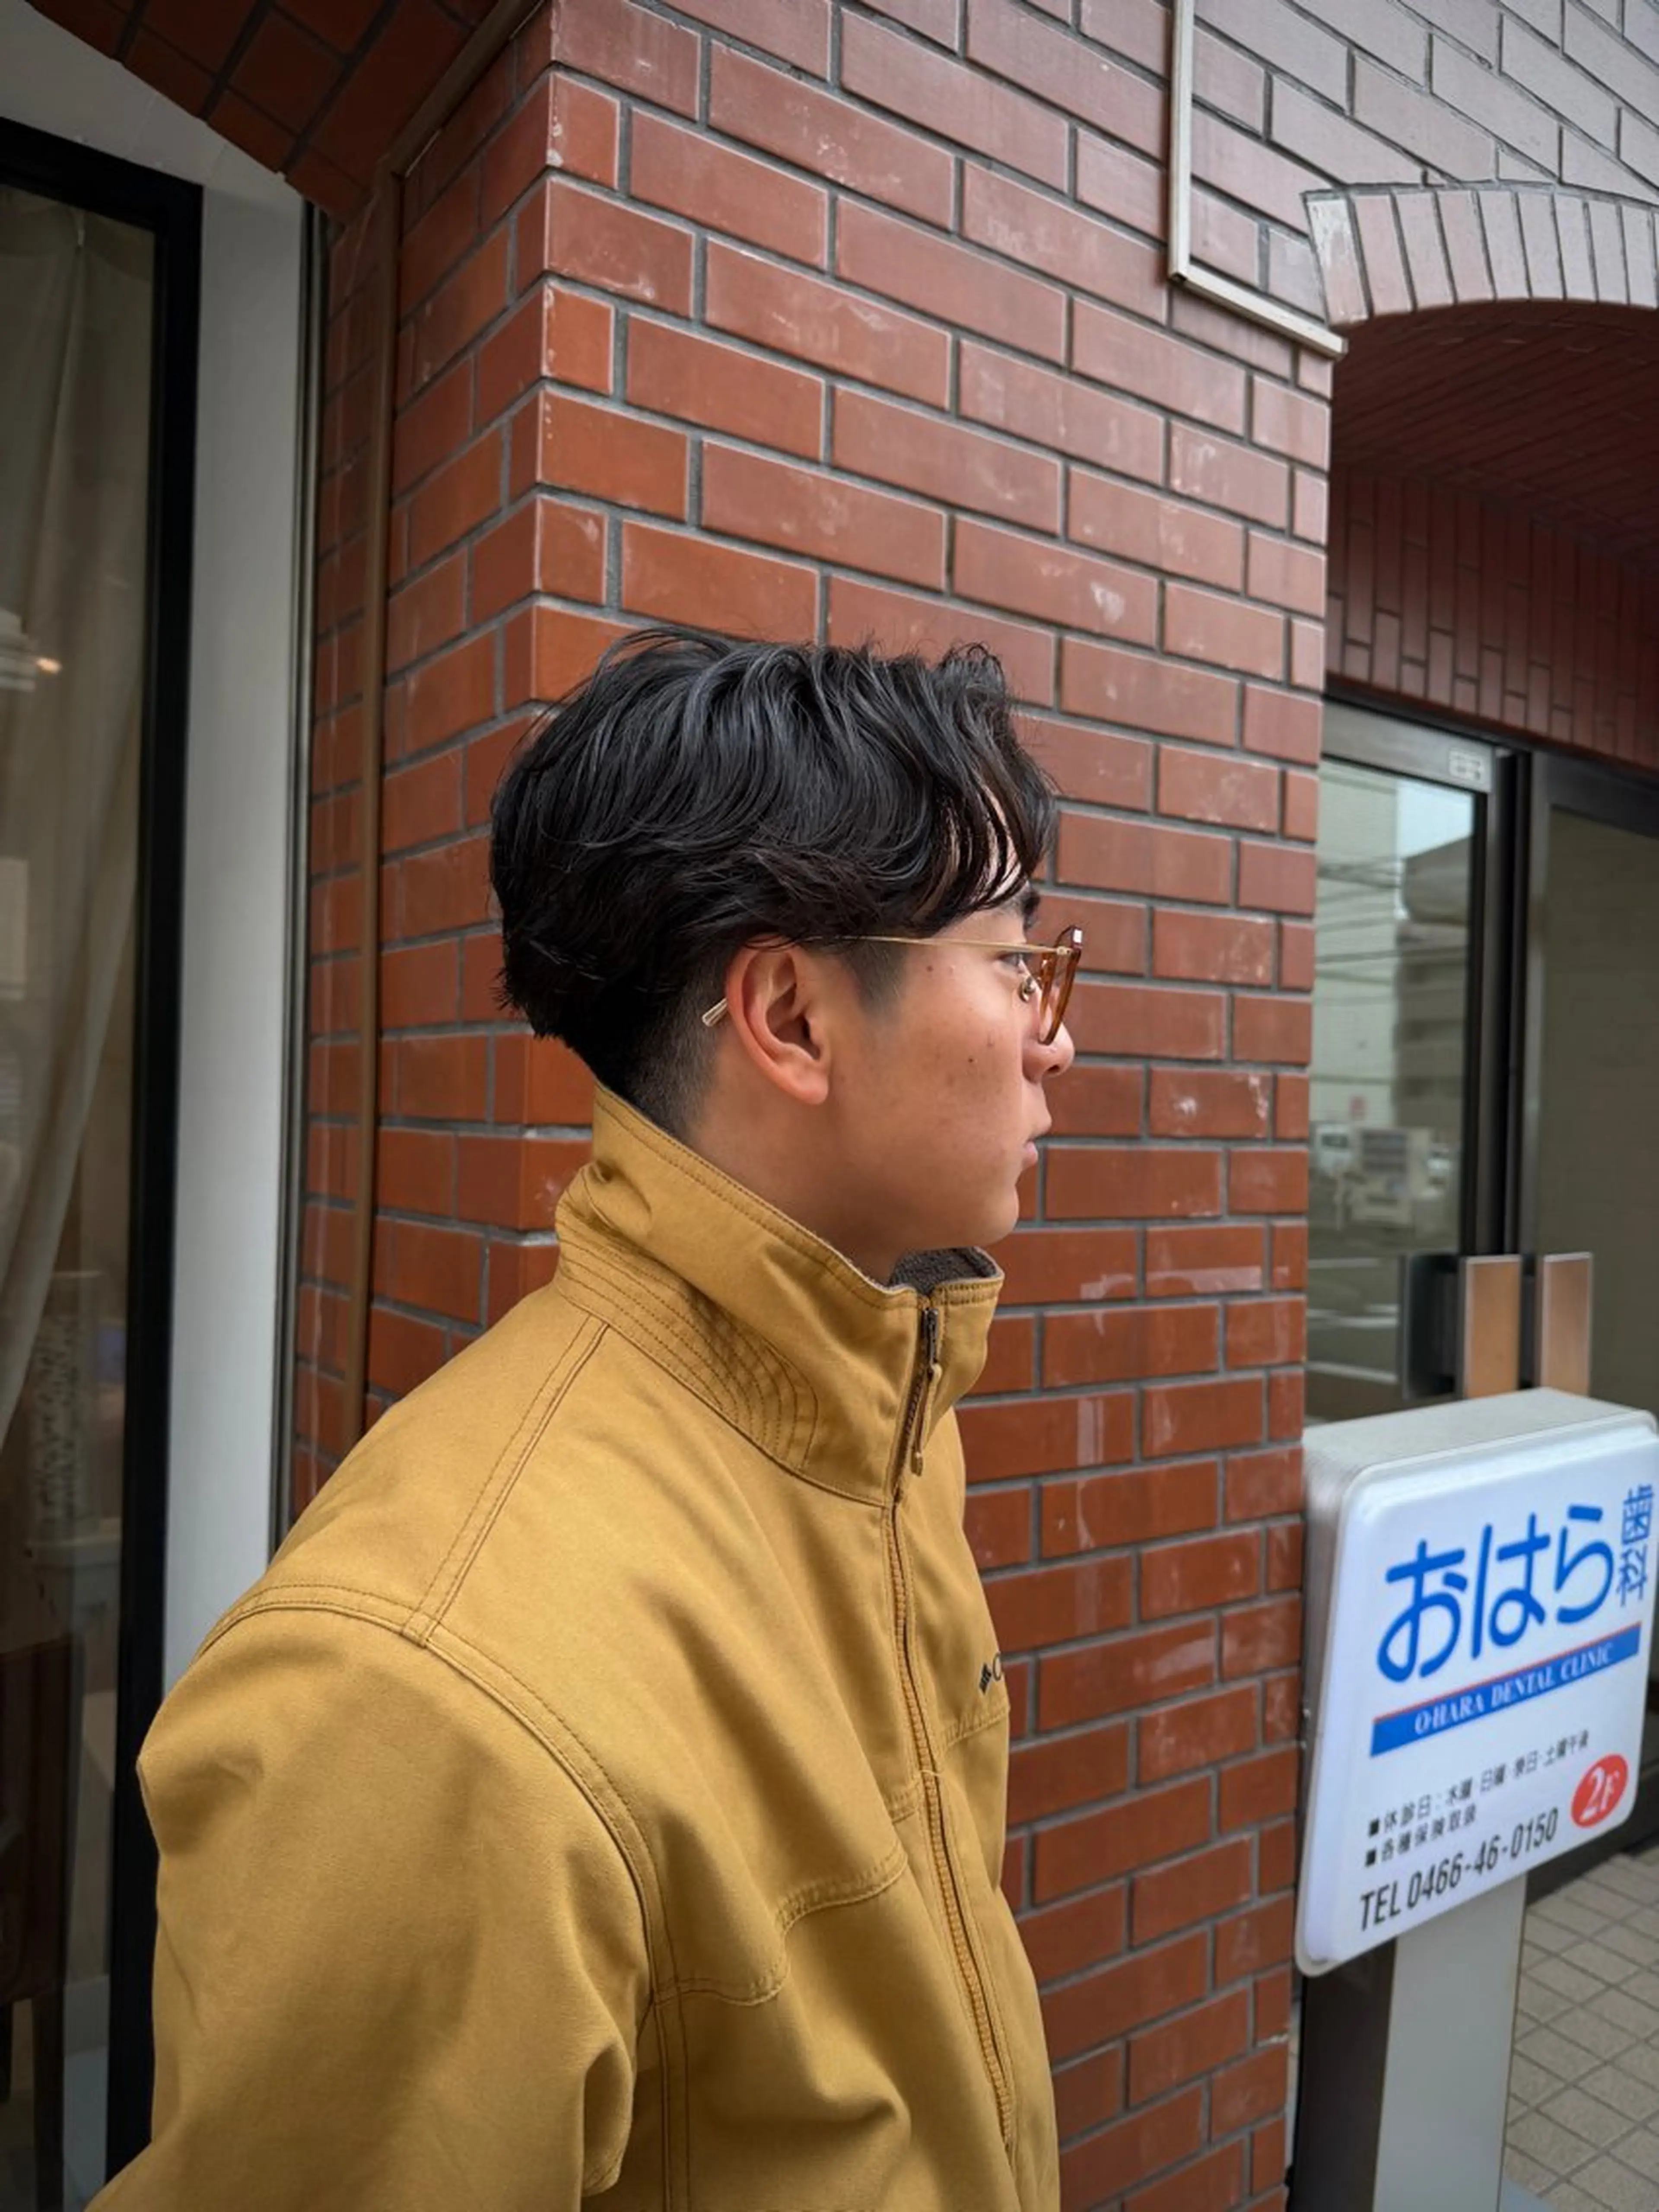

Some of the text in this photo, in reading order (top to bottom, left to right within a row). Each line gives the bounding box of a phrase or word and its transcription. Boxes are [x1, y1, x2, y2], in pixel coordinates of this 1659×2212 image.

[1377, 1504, 1614, 1682] おはら
[1616, 1484, 1653, 1607] 歯科
[1491, 1666, 1555, 1707] DENTAL
[1560, 1642, 1614, 1681] CLINIC
[1580, 1766, 1620, 1823] 2F
[1361, 1806, 1558, 1931] TEL 0466-46-0150
